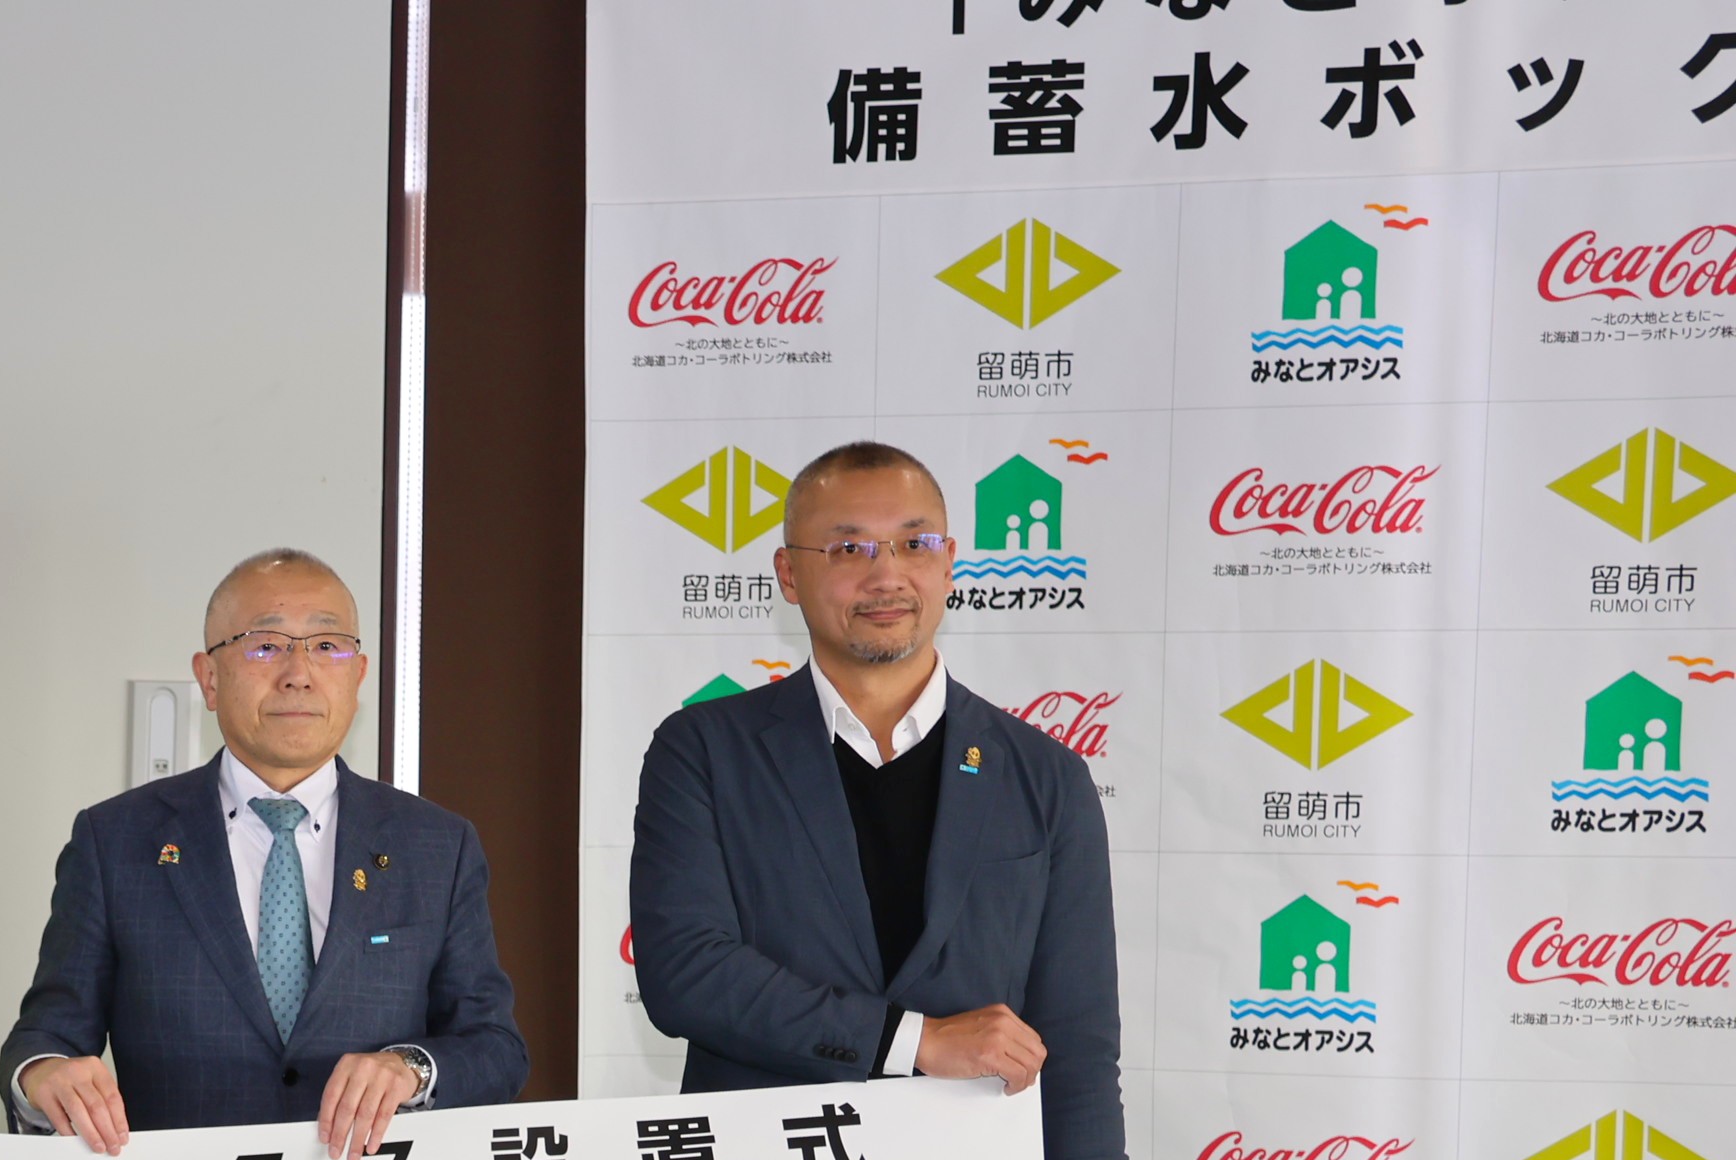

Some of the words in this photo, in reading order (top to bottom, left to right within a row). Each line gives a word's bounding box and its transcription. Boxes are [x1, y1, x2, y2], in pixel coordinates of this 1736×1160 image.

[628, 256, 839, 328] Coca-Cola
[1540, 325, 1736, 343] 北海道コカ・コーラボトリング株
[632, 351, 832, 367] 北海道コカ・コーラボトリング株式会社
[976, 349, 1074, 381] 留萌市
[1251, 357, 1401, 383] みなとオアシス
[976, 384, 1030, 398] RUMOI
[1035, 383, 1072, 397] CITY
[1209, 463, 1441, 536] Coca-Cola
[1212, 561, 1432, 577] 北海道コカ・コーラボトリング株式会社
[1589, 565, 1698, 595] 留萌市
[683, 574, 774, 602] 留萌市
[947, 587, 1085, 610] みなとオアシス
[683, 606, 733, 619] RUMOI
[738, 606, 774, 619] CITY
[1589, 599, 1648, 613] RUMOI
[1654, 598, 1696, 612] CITY
[1263, 790, 1362, 821] 留萌市
[1263, 825, 1318, 838] RUMOI
[1323, 824, 1361, 838] CITY
[1551, 808, 1707, 833] みなとオアシス
[1507, 917, 1736, 987] Coca-Cola
[1230, 1027, 1374, 1054] みなとオアシス
